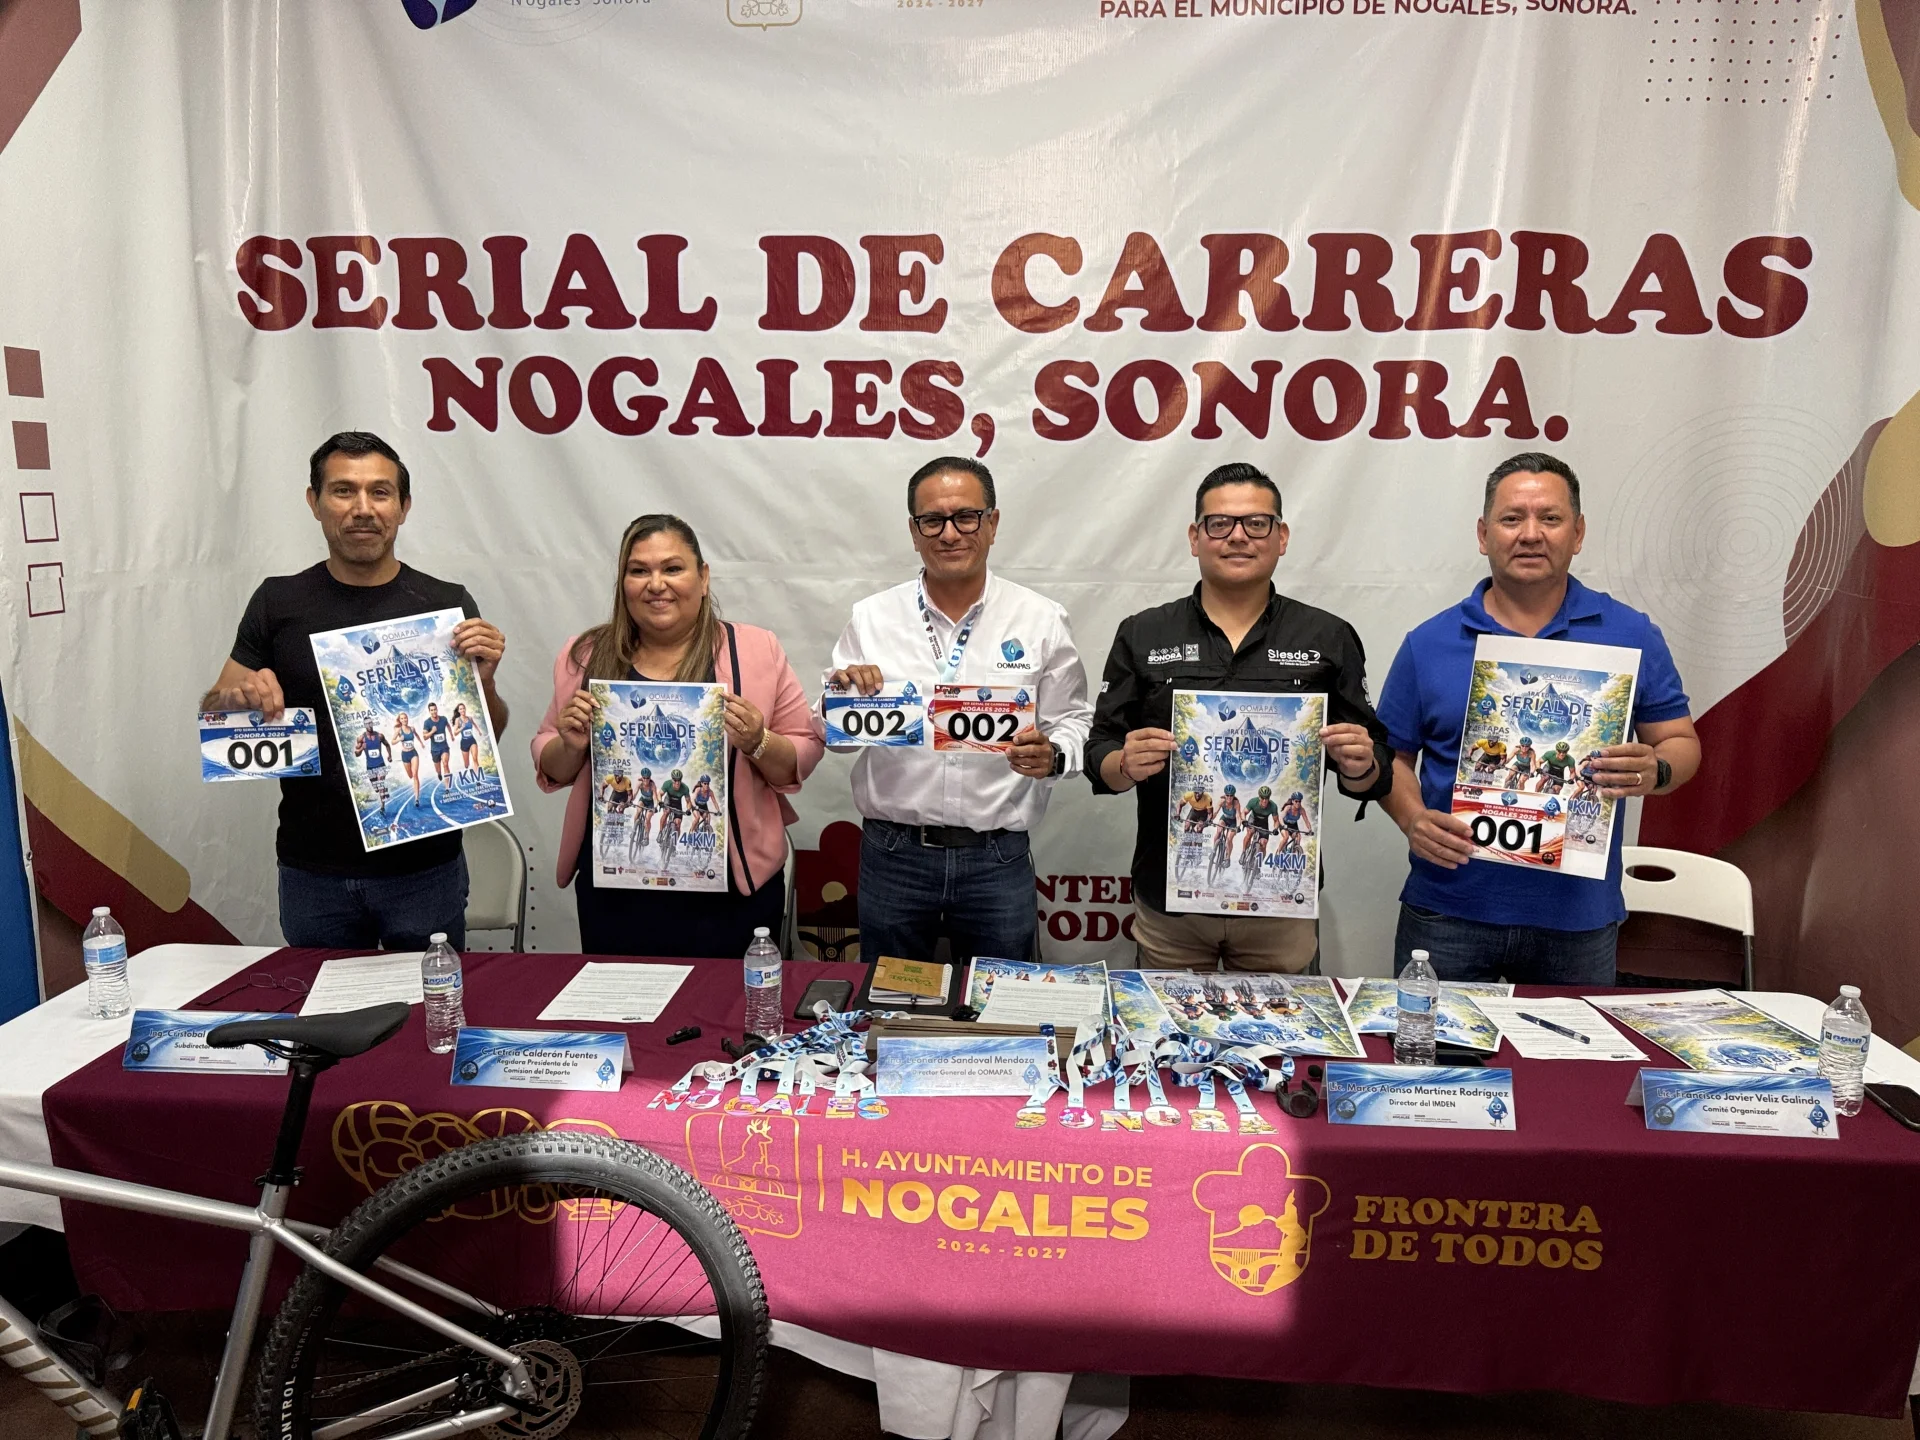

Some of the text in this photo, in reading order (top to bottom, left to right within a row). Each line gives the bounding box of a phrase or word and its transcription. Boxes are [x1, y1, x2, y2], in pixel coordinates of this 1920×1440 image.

[896, 0, 933, 8] 2024
[1099, 0, 1637, 18] PARA EL MUNICIPIO DE NOGALES, SONORA.
[235, 228, 1814, 339] SERIAL DE CARRERAS
[422, 355, 1570, 458] NOGALES, SONORA.
[382, 629, 420, 641] OOMAPAS
[1148, 652, 1182, 661] SONORA
[356, 656, 441, 687] SERIAL DE
[996, 662, 1031, 670] OOMAPAS
[360, 674, 444, 698] CARRERAS
[1240, 705, 1278, 713] OOMAPAS
[1502, 695, 1593, 717] SERIAL DE
[843, 710, 906, 737] 002
[948, 712, 1019, 742] 002
[1500, 710, 1592, 727] CARRERAS
[620, 722, 696, 738] SERIAL DE
[620, 740, 697, 750] CARRERAS
[1204, 736, 1290, 753] SERIAL DE
[227, 739, 293, 770] 001
[1204, 754, 1290, 766] CARRERAS
[444, 766, 486, 789] 7 KM
[1481, 808, 1518, 819] NOGALES
[1573, 800, 1602, 816] KM
[671, 832, 716, 848] 14 KM
[1470, 815, 1543, 854] 001
[1256, 853, 1306, 870] 14 KM
[150, 1029, 206, 1040] Ing. Cristobal
[492, 1048, 521, 1057] Leticia
[522, 1048, 563, 1058] Calderón
[565, 1050, 598, 1060] Fuentes
[496, 1058, 526, 1066] Regidora
[528, 1059, 562, 1067] Presidenta
[907, 1056, 949, 1064] Leonardo
[951, 1055, 992, 1064] Sandoval
[994, 1056, 1035, 1064] Mendoza
[545, 1068, 571, 1076] Deporte
[1328, 1082, 1509, 1099] Lic. Marco Alonso Martínez Rodríguez
[1676, 1089, 1721, 1101] Francisco
[1723, 1093, 1753, 1102] Javier
[1754, 1094, 1779, 1103] Veliz
[1781, 1095, 1821, 1105] Galindo
[1389, 1099, 1417, 1107] Director
[1432, 1100, 1456, 1108] IMDEN
[1702, 1105, 1779, 1116] Comité Organizador
[841, 1147, 1153, 1188] H. AYUNTAMIENTO DE
[841, 1177, 1151, 1242] NOGALES
[1352, 1194, 1602, 1234] FRONTERA
[936, 1237, 992, 1256] 2024
[1013, 1245, 1068, 1260] 2027
[1349, 1229, 1604, 1271] DE TODOS
[290, 1325, 312, 1369] CONTROL
